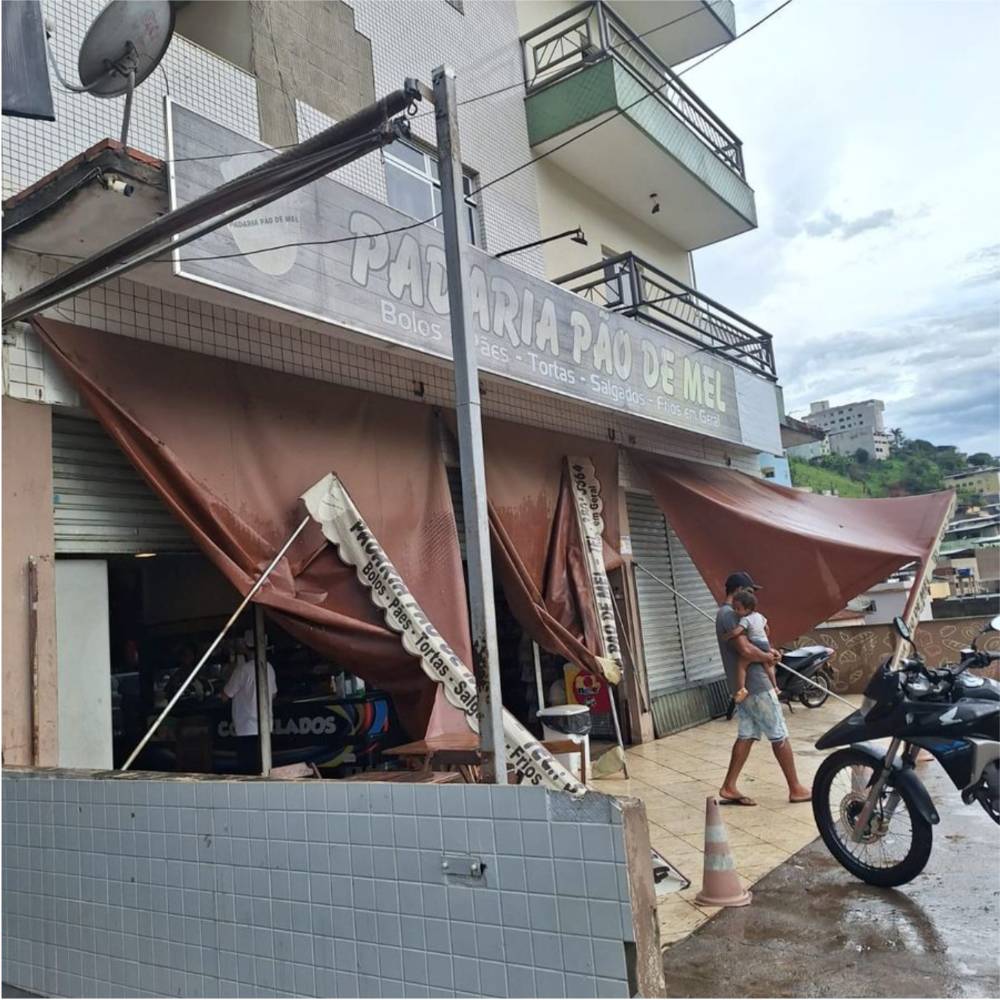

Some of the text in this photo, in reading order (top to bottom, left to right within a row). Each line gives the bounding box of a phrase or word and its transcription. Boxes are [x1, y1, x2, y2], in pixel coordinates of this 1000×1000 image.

[380, 300, 442, 341] Bolos
[528, 352, 576, 384] Tortas
[591, 373, 645, 406] Salgados
[570, 309, 632, 382] PÃO
[641, 337, 676, 394] DE
[682, 356, 727, 413] MEL
[362, 562, 387, 596] Bolos
[388, 597, 413, 631] Pães
[414, 631, 450, 676] Tortas
[510, 745, 543, 786] Frios
